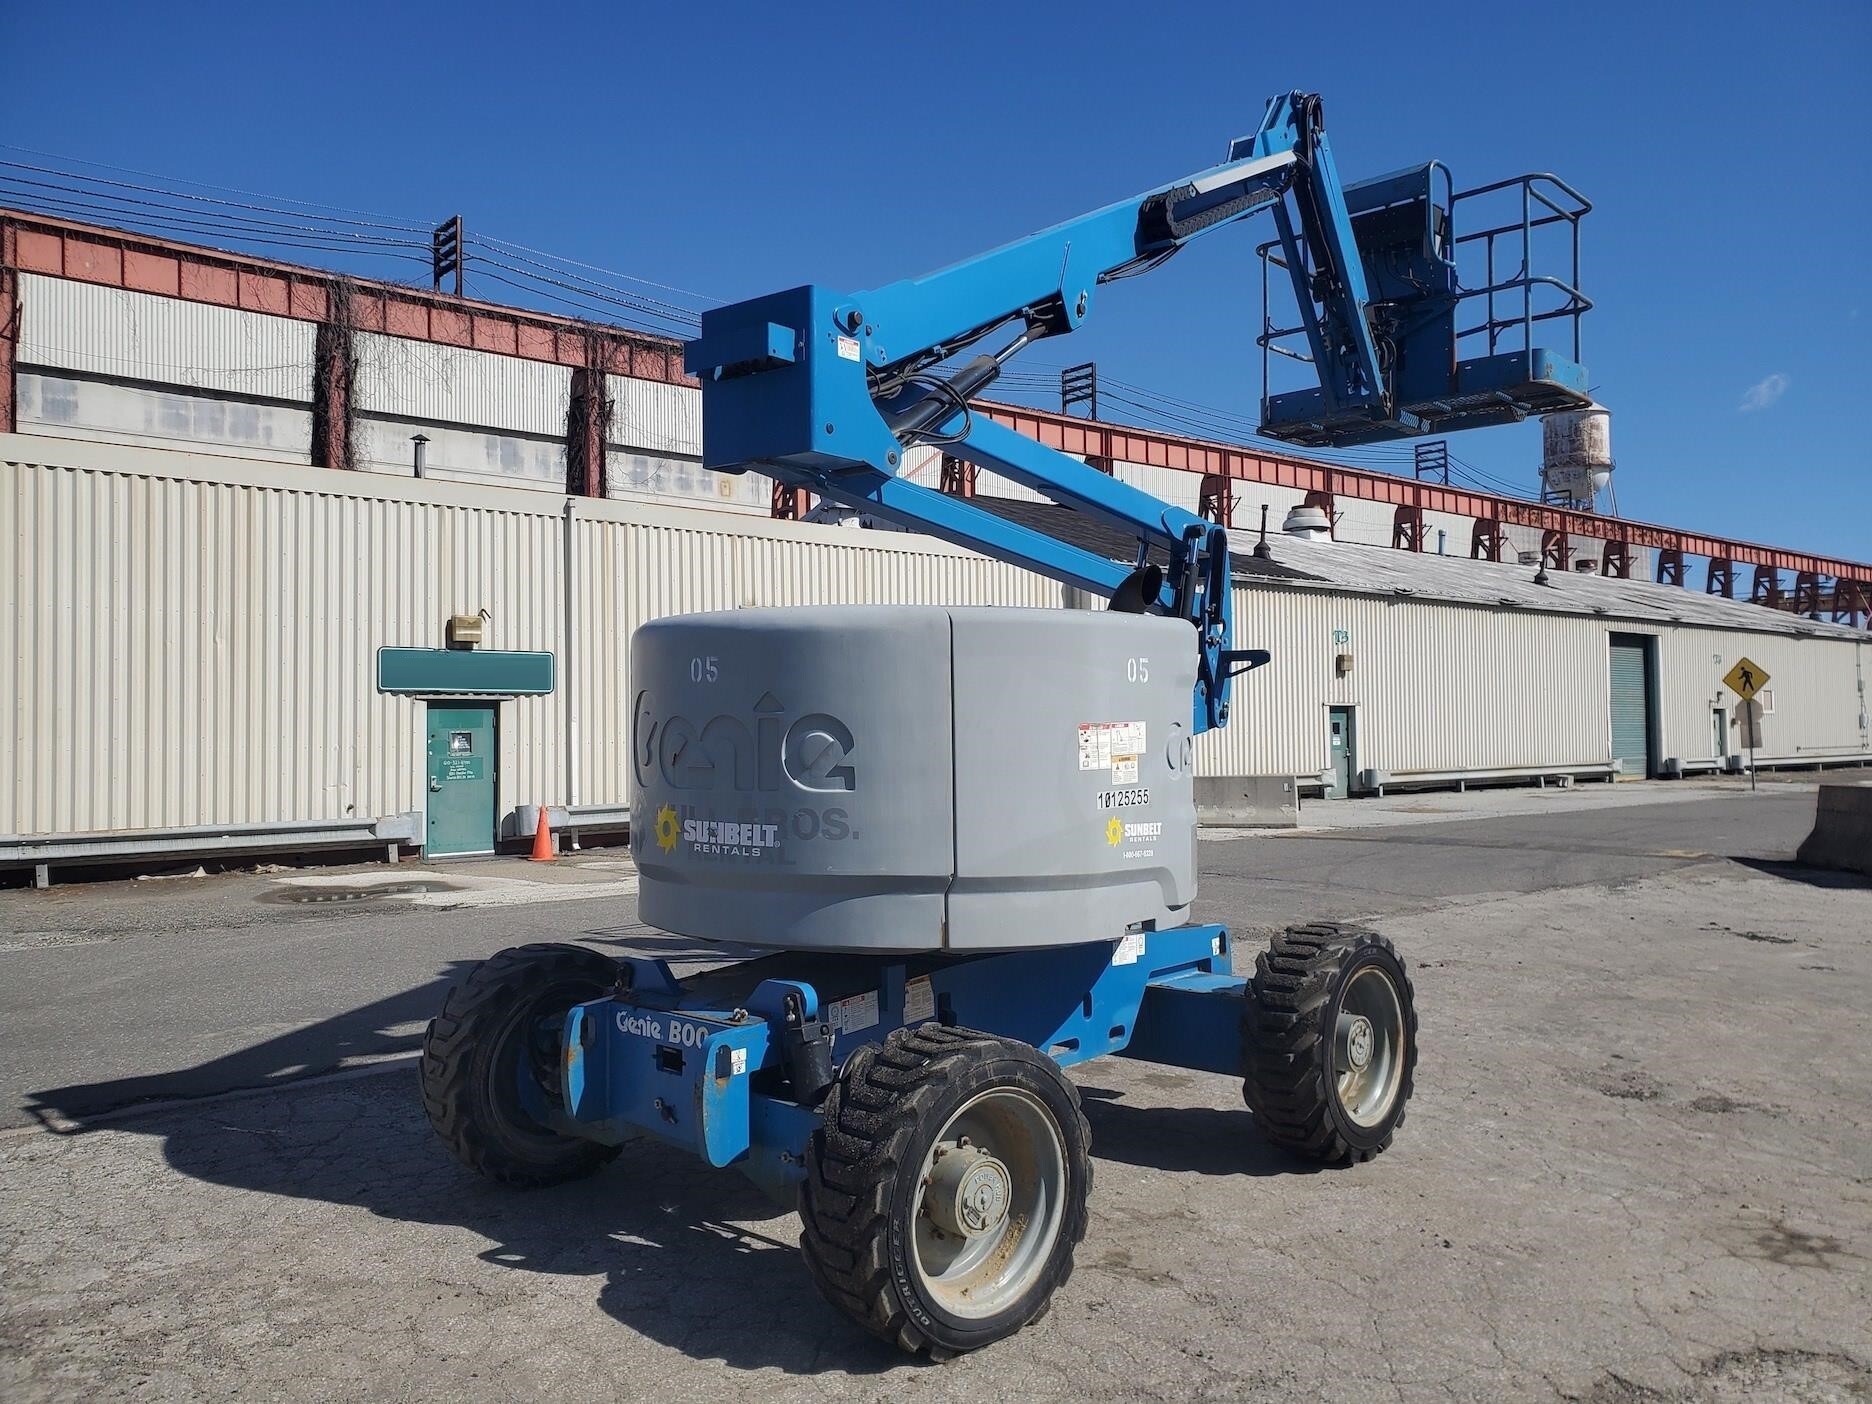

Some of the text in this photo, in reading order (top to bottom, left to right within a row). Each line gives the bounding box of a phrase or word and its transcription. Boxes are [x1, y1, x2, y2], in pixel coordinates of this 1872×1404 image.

[690, 656, 719, 683] 05
[1127, 657, 1149, 683] 05
[1098, 789, 1149, 809] 10125255
[683, 819, 778, 848] SUNBELT
[1124, 822, 1163, 837] SUNBELT
[1129, 835, 1157, 843] RENTALS
[693, 843, 761, 857] RENTALS
[615, 1010, 709, 1050] Genie BOO
